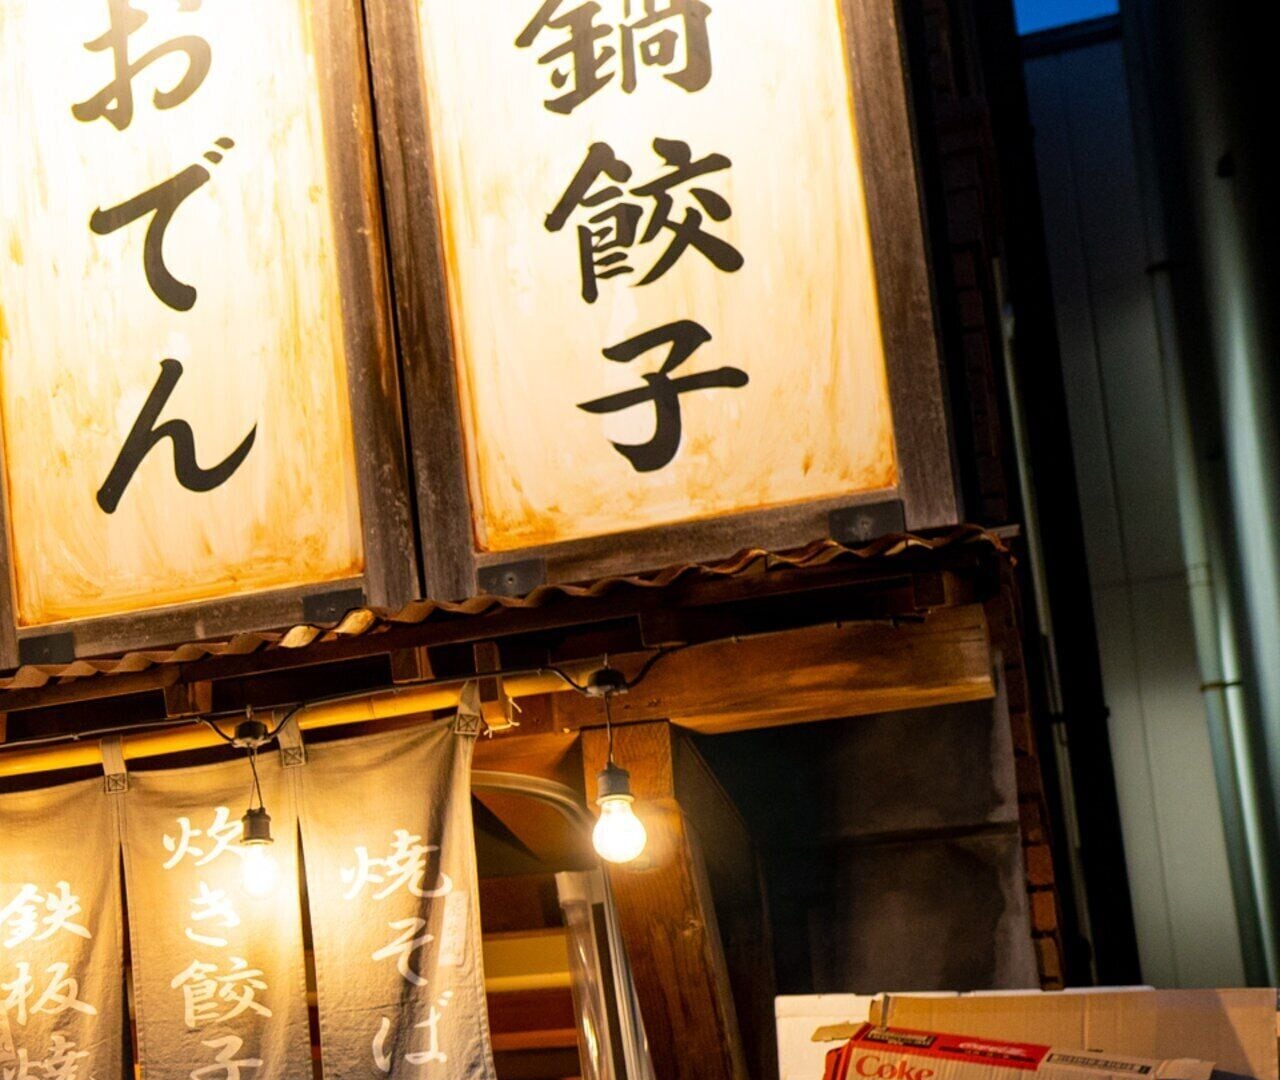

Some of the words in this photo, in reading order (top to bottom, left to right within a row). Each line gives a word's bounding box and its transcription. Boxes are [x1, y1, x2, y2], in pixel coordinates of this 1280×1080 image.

[70, 0, 259, 516] おでん
[341, 829, 453, 1073] 焼そば
